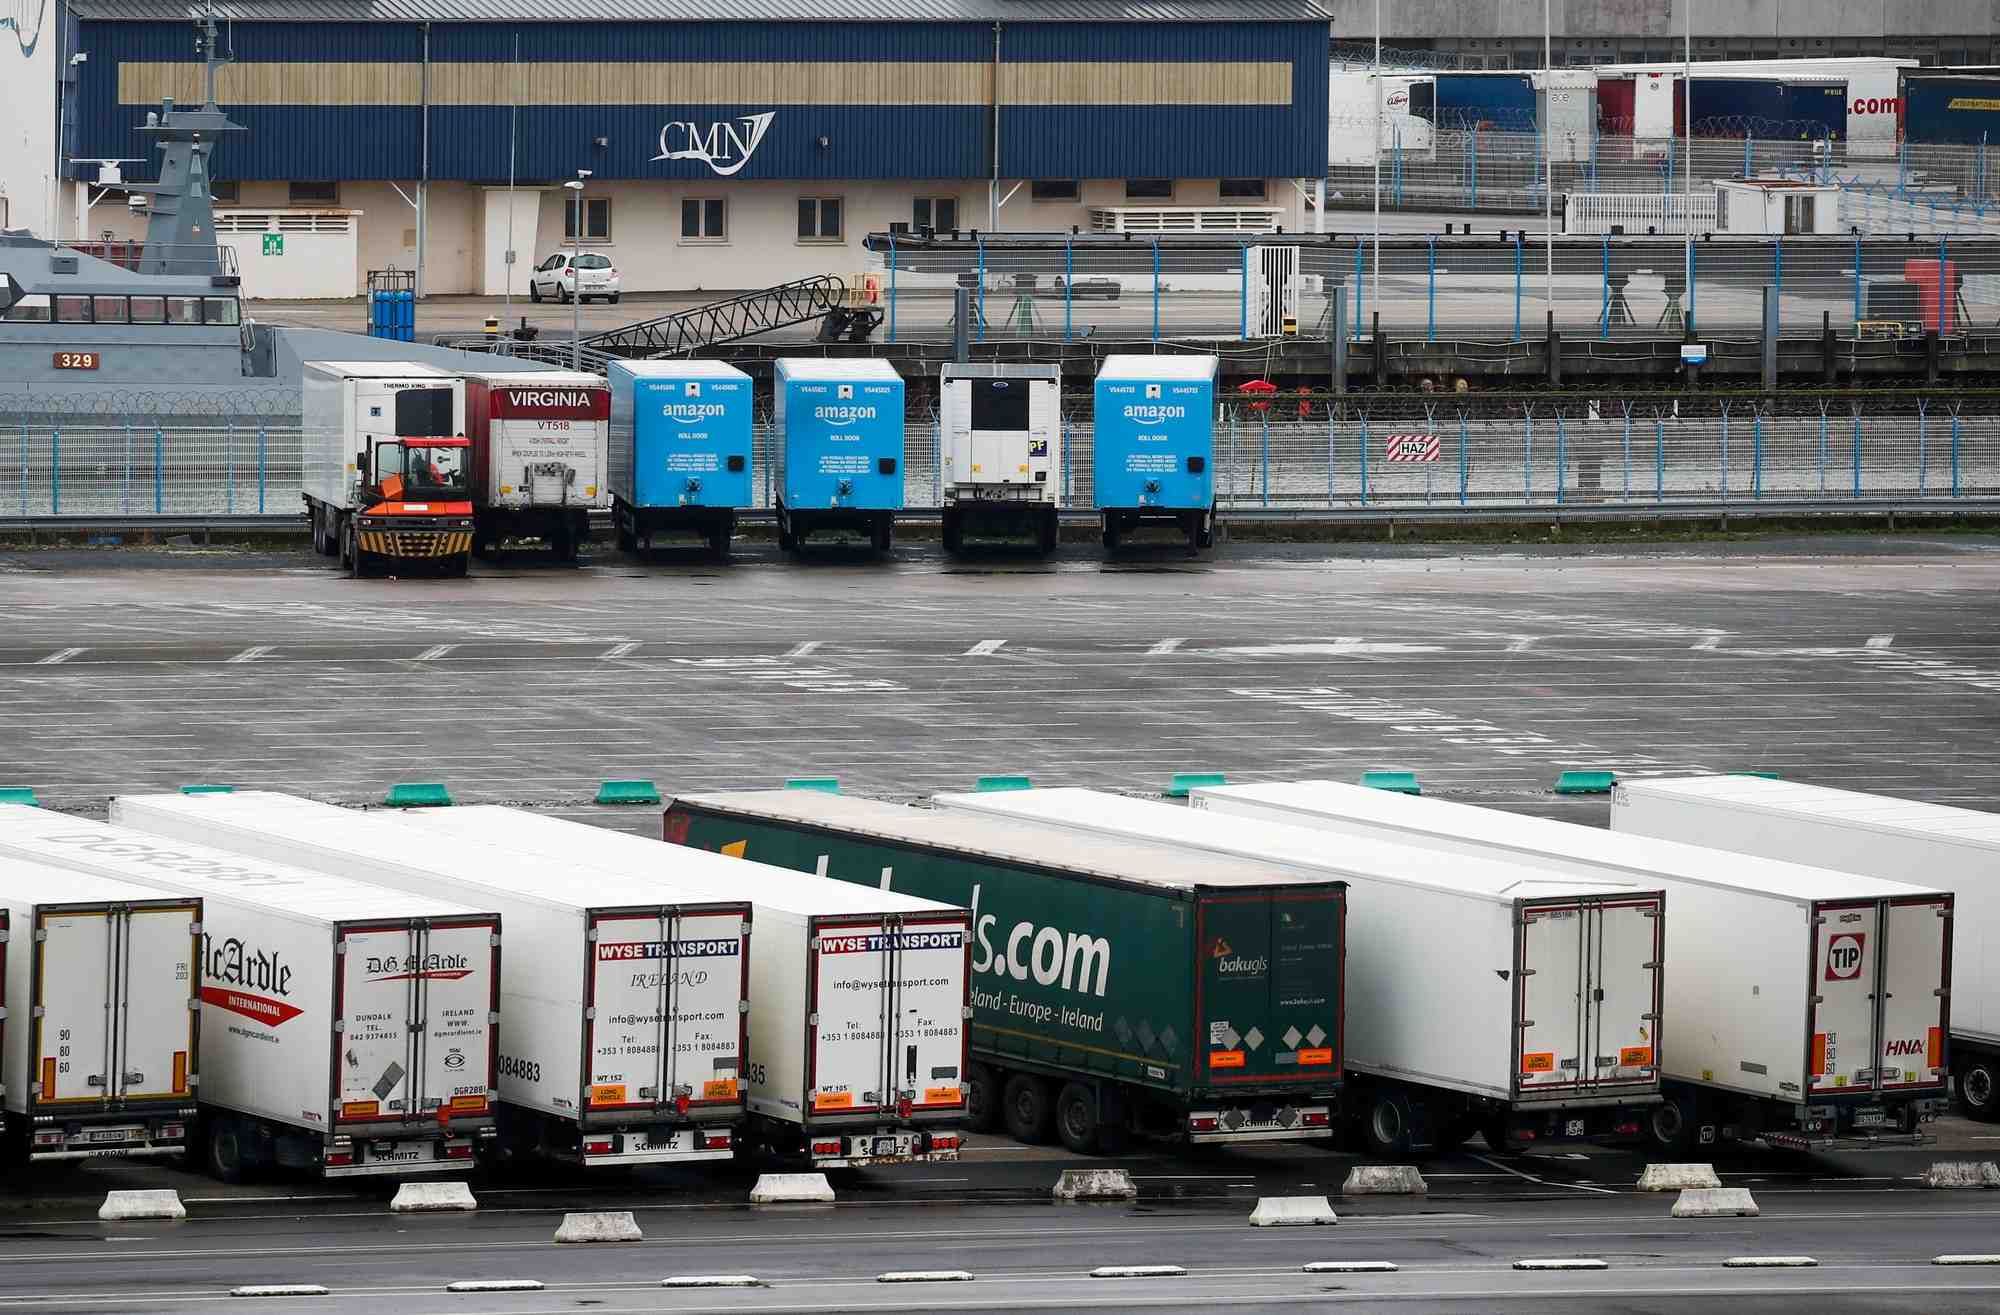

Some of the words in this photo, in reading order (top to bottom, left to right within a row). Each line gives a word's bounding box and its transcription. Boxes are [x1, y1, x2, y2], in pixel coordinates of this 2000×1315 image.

[1848, 97, 1905, 115] .com
[656, 119, 757, 162] CMN
[61, 353, 93, 368] 329
[509, 391, 591, 407] VIRGINIA
[663, 403, 725, 417] amazon
[815, 405, 876, 419] amazon
[1123, 404, 1185, 418] amazon
[1401, 443, 1425, 454] HAZ
[822, 938, 866, 952] WYSE
[868, 933, 961, 950] TRANSPORT
[600, 945, 643, 960] WYSE
[645, 941, 738, 957] TRANSPORT
[366, 956, 400, 973] D.G.
[1832, 947, 1859, 969] TIP
[1219, 957, 1267, 975] bakugls
[228, 992, 281, 1017] INTERNATIONAL
[355, 1013, 392, 1022] DUNDALK
[441, 1008, 474, 1017] IRELAND
[1009, 995, 1052, 1022] Europe
[1061, 1005, 1104, 1033] Ireland
[917, 1017, 936, 1026] Fax:
[59, 1029, 70, 1041] 90
[695, 1032, 713, 1041] Fax:
[821, 1033, 841, 1041] +353
[923, 1027, 958, 1037] 8084883
[1826, 1033, 1837, 1045] 90
[59, 1046, 70, 1057] 80
[597, 1047, 617, 1056] +353
[701, 1042, 736, 1051] 8084883
[1885, 1039, 1927, 1058] HNA
[1826, 1047, 1836, 1060] 80
[59, 1062, 70, 1073] 60
[1825, 1063, 1836, 1075] 60
[375, 1151, 419, 1162] SCHMITZ
